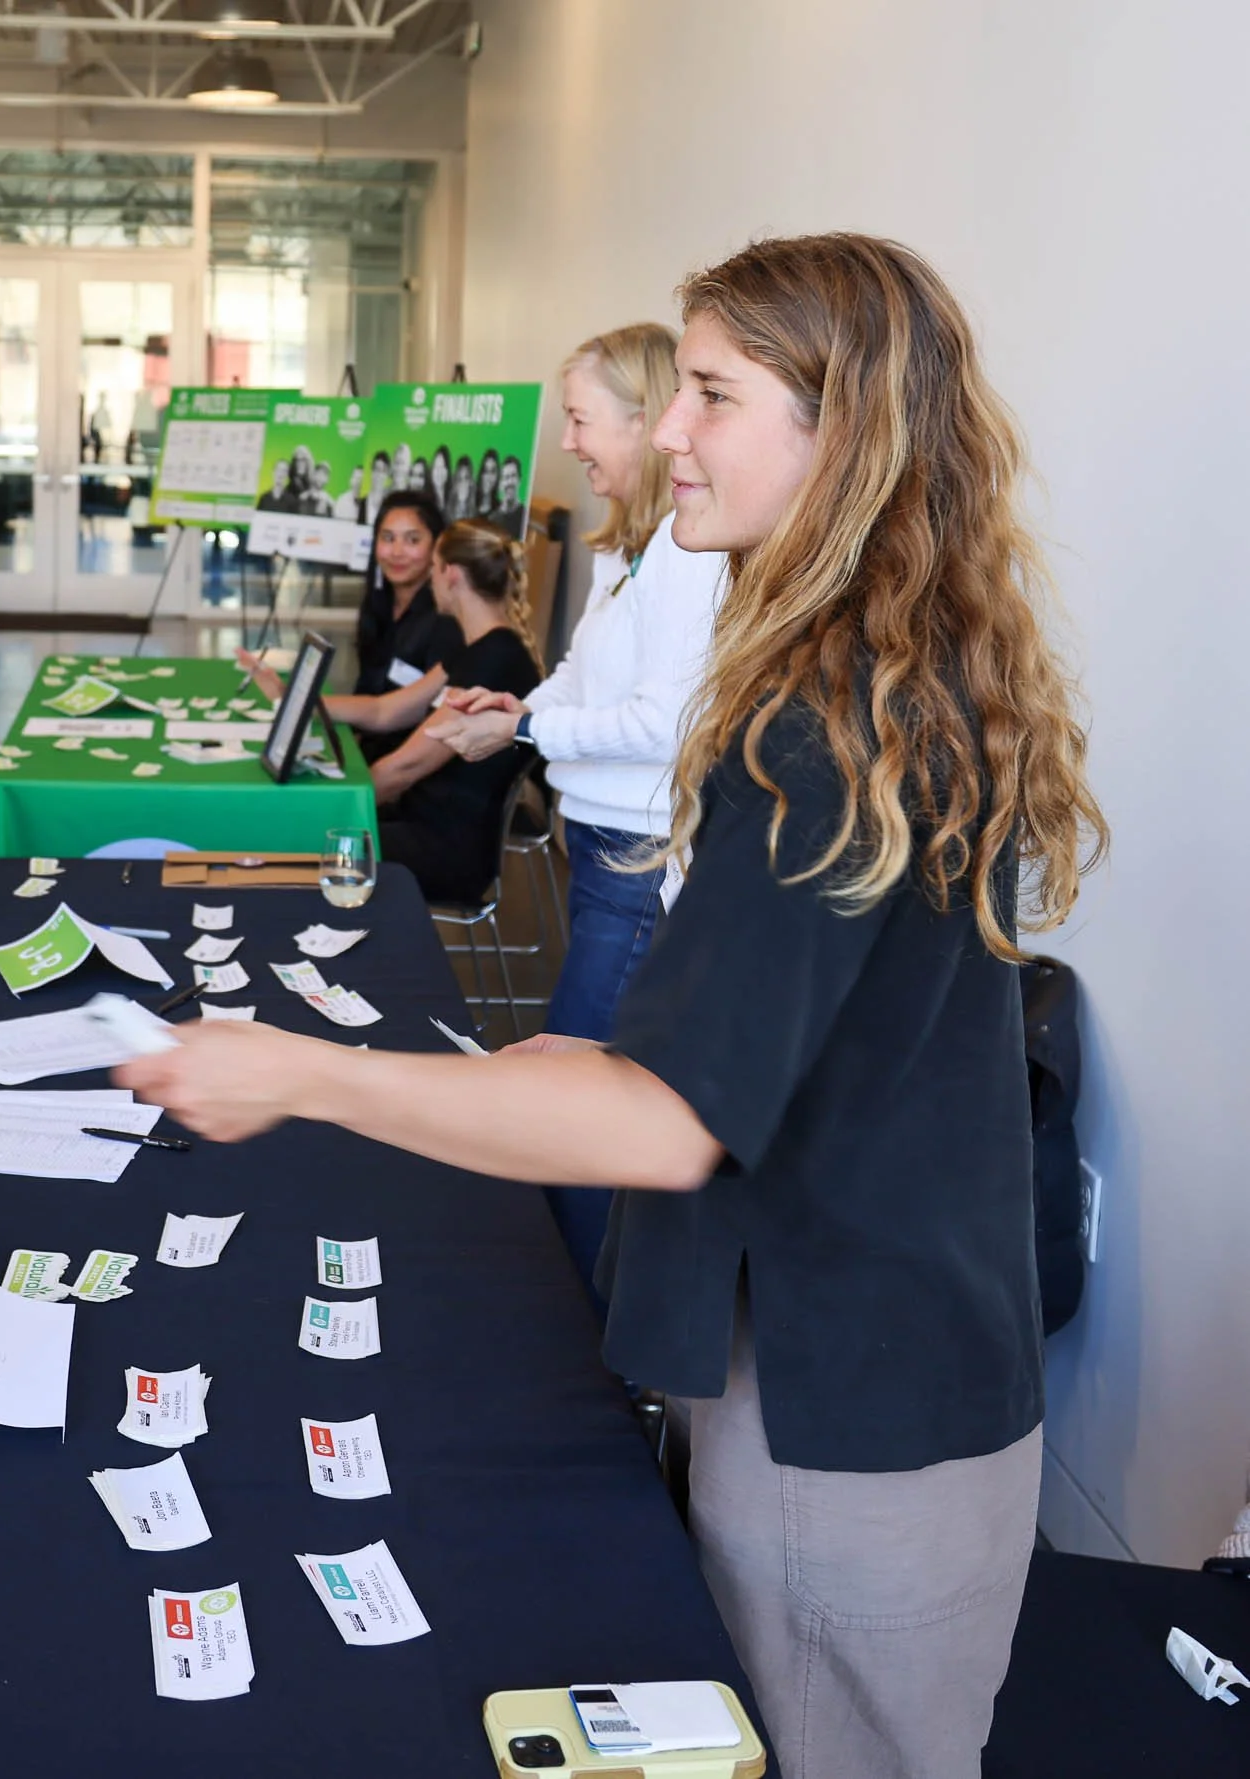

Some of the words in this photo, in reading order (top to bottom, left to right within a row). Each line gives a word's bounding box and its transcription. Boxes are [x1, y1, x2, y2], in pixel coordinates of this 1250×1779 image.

[273, 402, 331, 427] SPEAKERS
[432, 393, 504, 425] FINALISTS
[22, 1254, 54, 1299] Naturally
[86, 1256, 131, 1300] Naturally
[342, 1460, 352, 1478] Aaron
[156, 1509, 167, 1521] Jon
[366, 1569, 378, 1581] LLC
[353, 1578, 371, 1601] Farrell
[372, 1582, 388, 1605] Catalyst
[366, 1601, 382, 1620] Liam
[385, 1604, 398, 1624] Nexus
[196, 1615, 208, 1642] Adams
[214, 1619, 224, 1639] Group
[227, 1629, 237, 1644] CEO
[200, 1643, 214, 1670] Wayne
[217, 1639, 226, 1661] Adams
